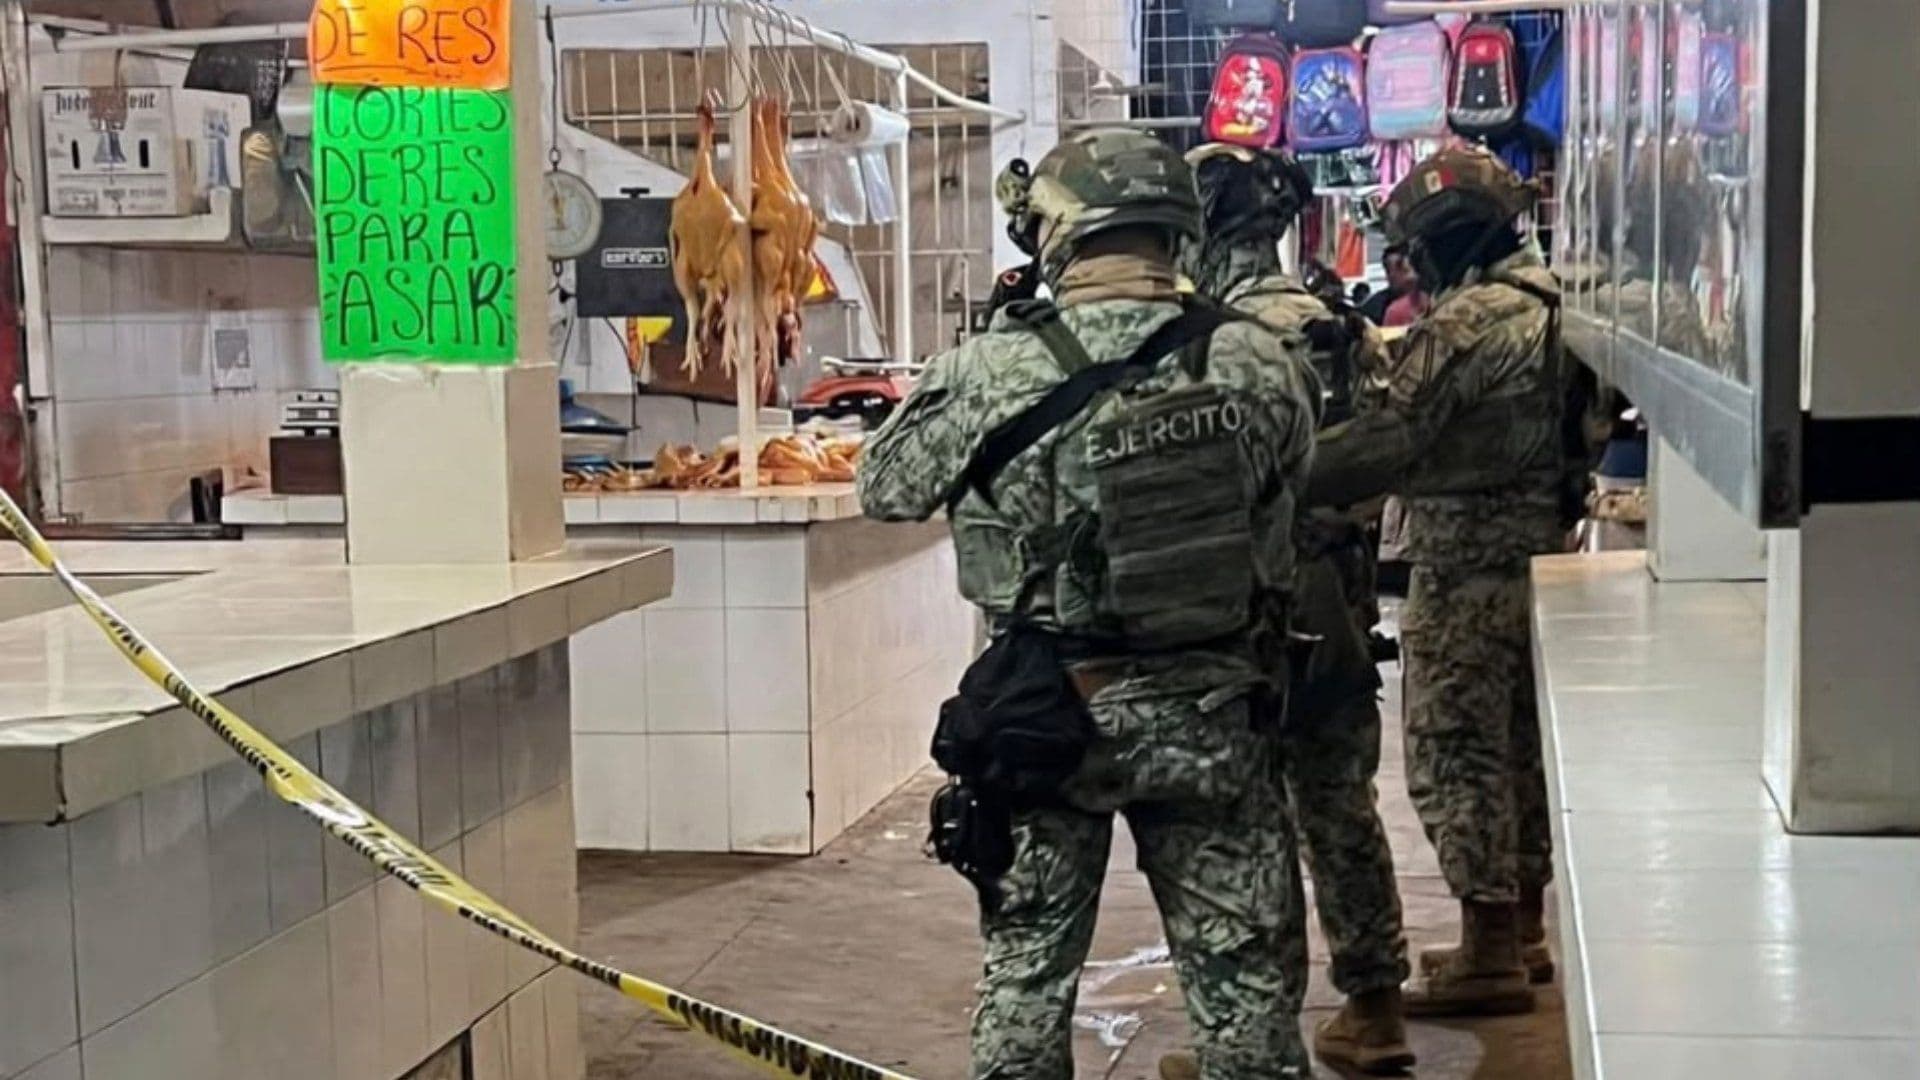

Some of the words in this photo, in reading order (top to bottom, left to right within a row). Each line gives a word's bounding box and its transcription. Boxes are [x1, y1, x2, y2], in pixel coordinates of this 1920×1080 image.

[313, 6, 368, 64] DE
[399, 6, 496, 64] RES
[324, 209, 479, 264] PARA
[339, 262, 506, 346] ASAR
